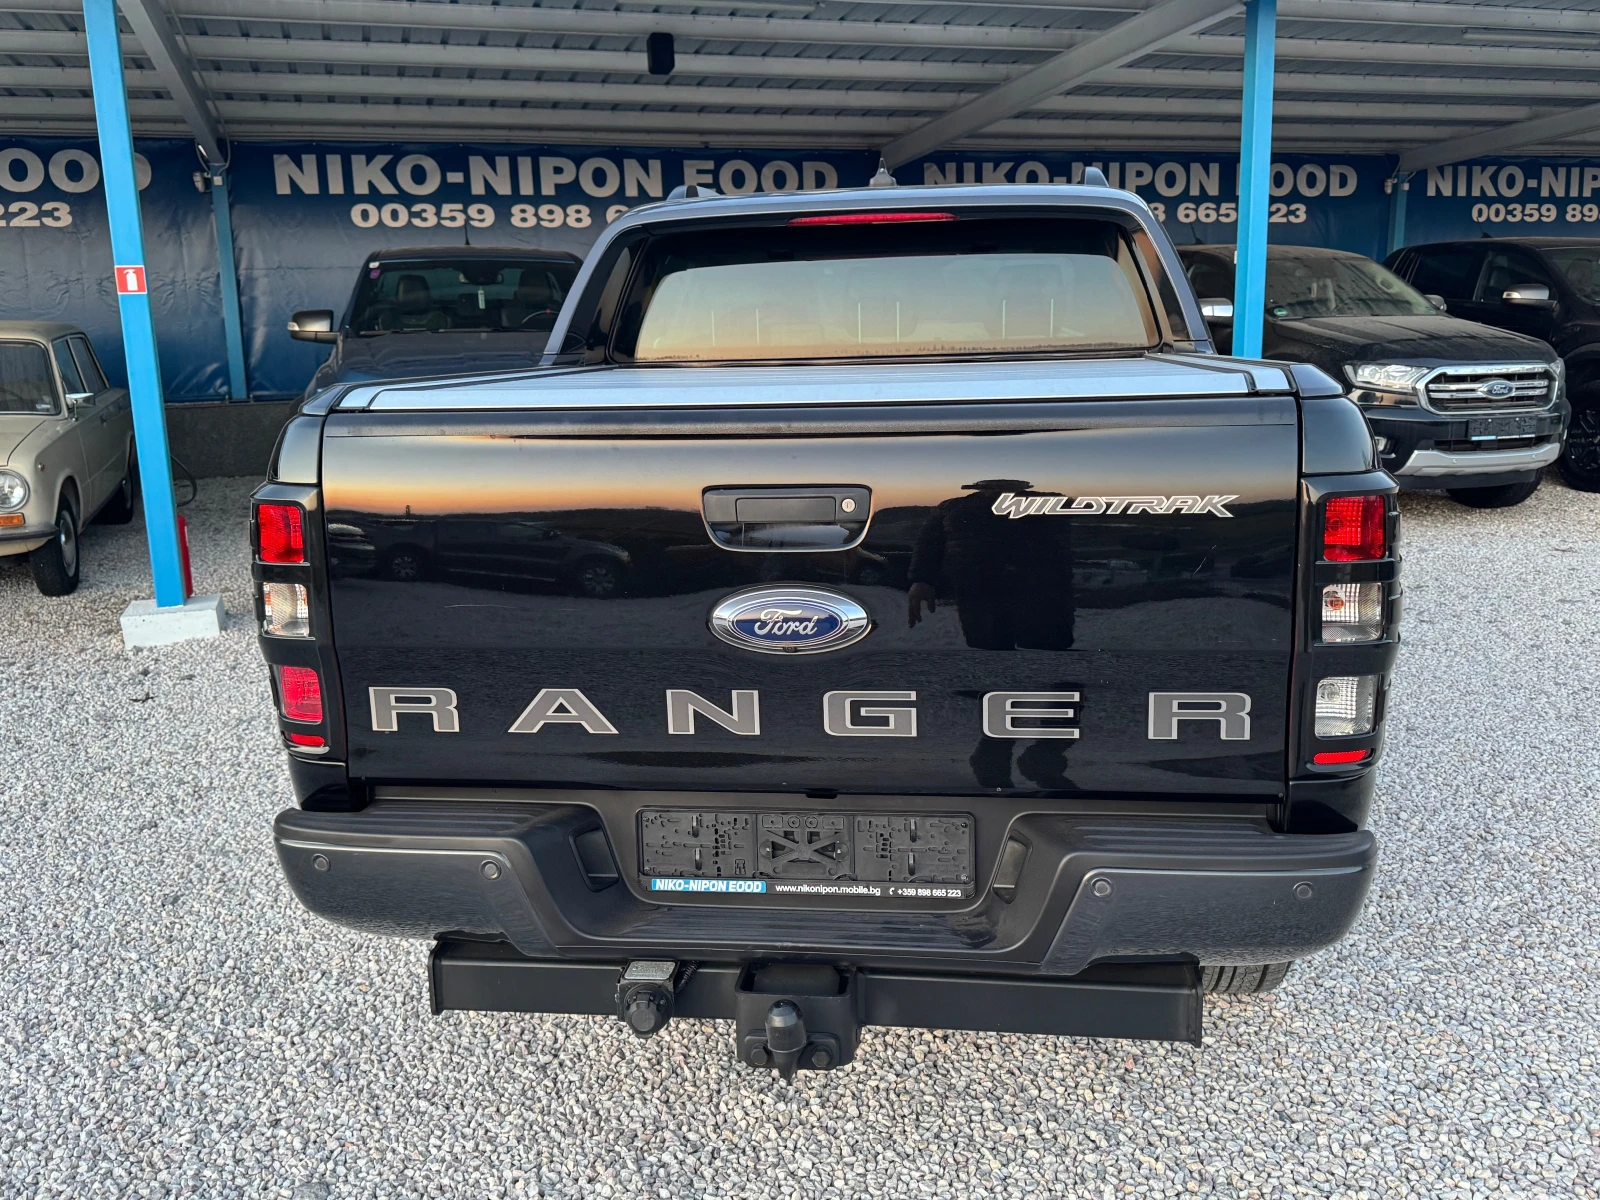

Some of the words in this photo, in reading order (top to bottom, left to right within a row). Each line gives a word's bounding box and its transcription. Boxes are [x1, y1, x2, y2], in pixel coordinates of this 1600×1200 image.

[273, 154, 663, 198] NIKO-NIPON
[683, 159, 838, 195] EOOD
[1236, 163, 1358, 197] OOD
[0, 201, 73, 228] 23
[350, 203, 496, 228] 00359
[510, 204, 592, 228] 898
[1176, 203, 1237, 223] 665
[1471, 203, 1558, 223] 00359
[1492, 384, 1508, 394] Ford
[990, 492, 1240, 520] WILDTRAK
[753, 608, 819, 636] Ford
[367, 685, 1253, 742] RANGER
[655, 878, 727, 892] NIKO-NIPON
[728, 880, 763, 893] EOOD
[775, 884, 881, 896] www.nikonipon.mobile.bg
[897, 888, 916, 896] +359
[947, 889, 961, 897] 223
